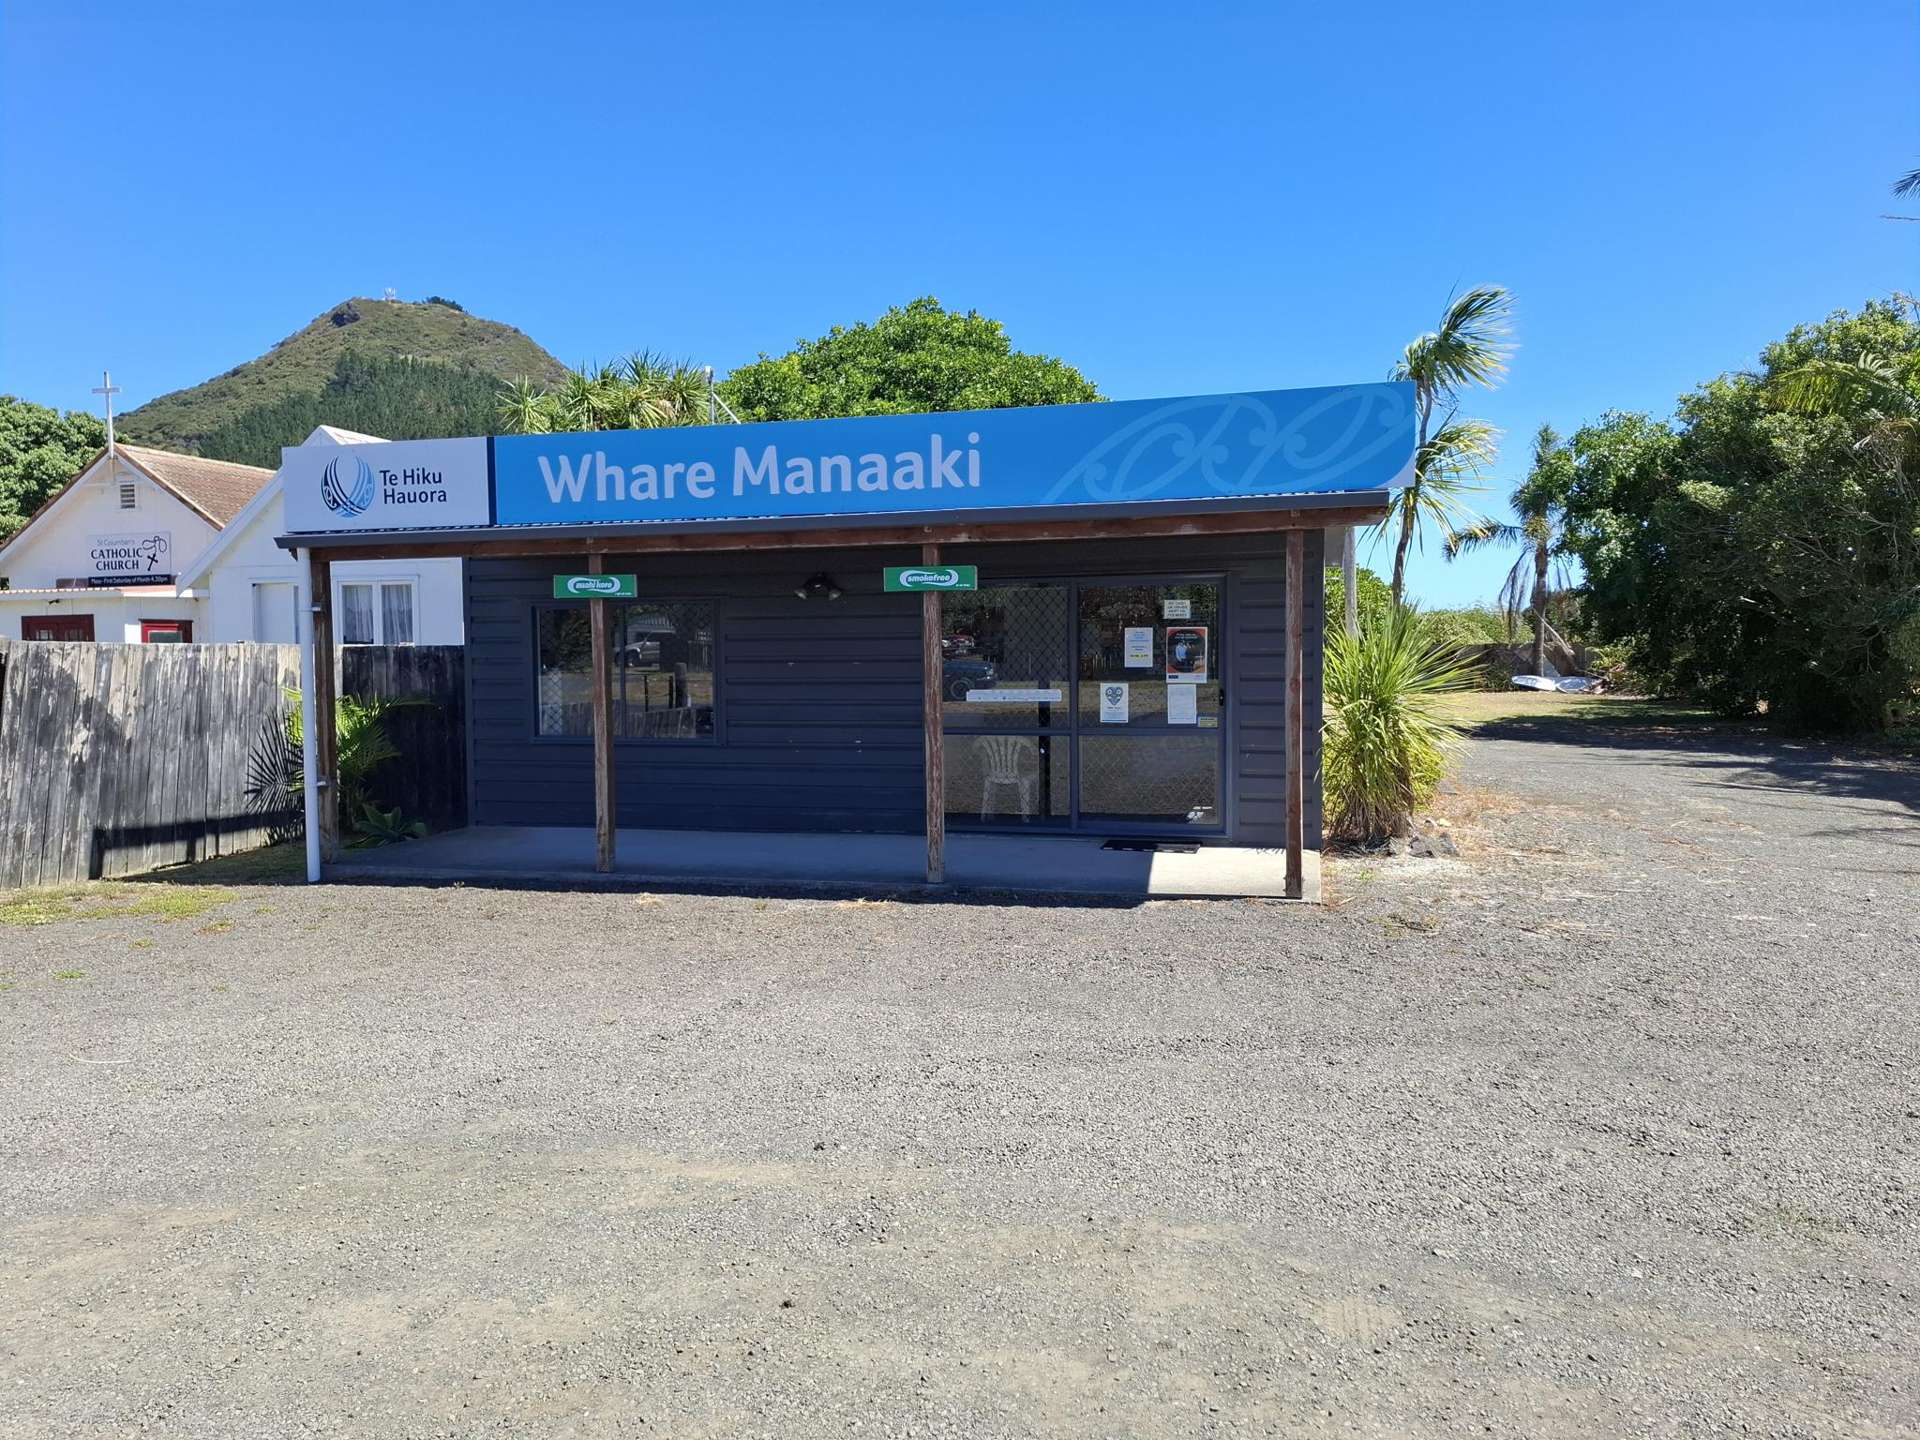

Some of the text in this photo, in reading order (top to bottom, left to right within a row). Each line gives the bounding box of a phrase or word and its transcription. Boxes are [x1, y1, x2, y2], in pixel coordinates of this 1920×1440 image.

[537, 432, 981, 503] Whare Manaaki
[379, 467, 442, 486] Te Hiku
[383, 488, 447, 505] Hauora
[91, 547, 143, 559] CATHOLIC
[96, 560, 139, 571] CHURCH
[907, 572, 951, 582] smokefree
